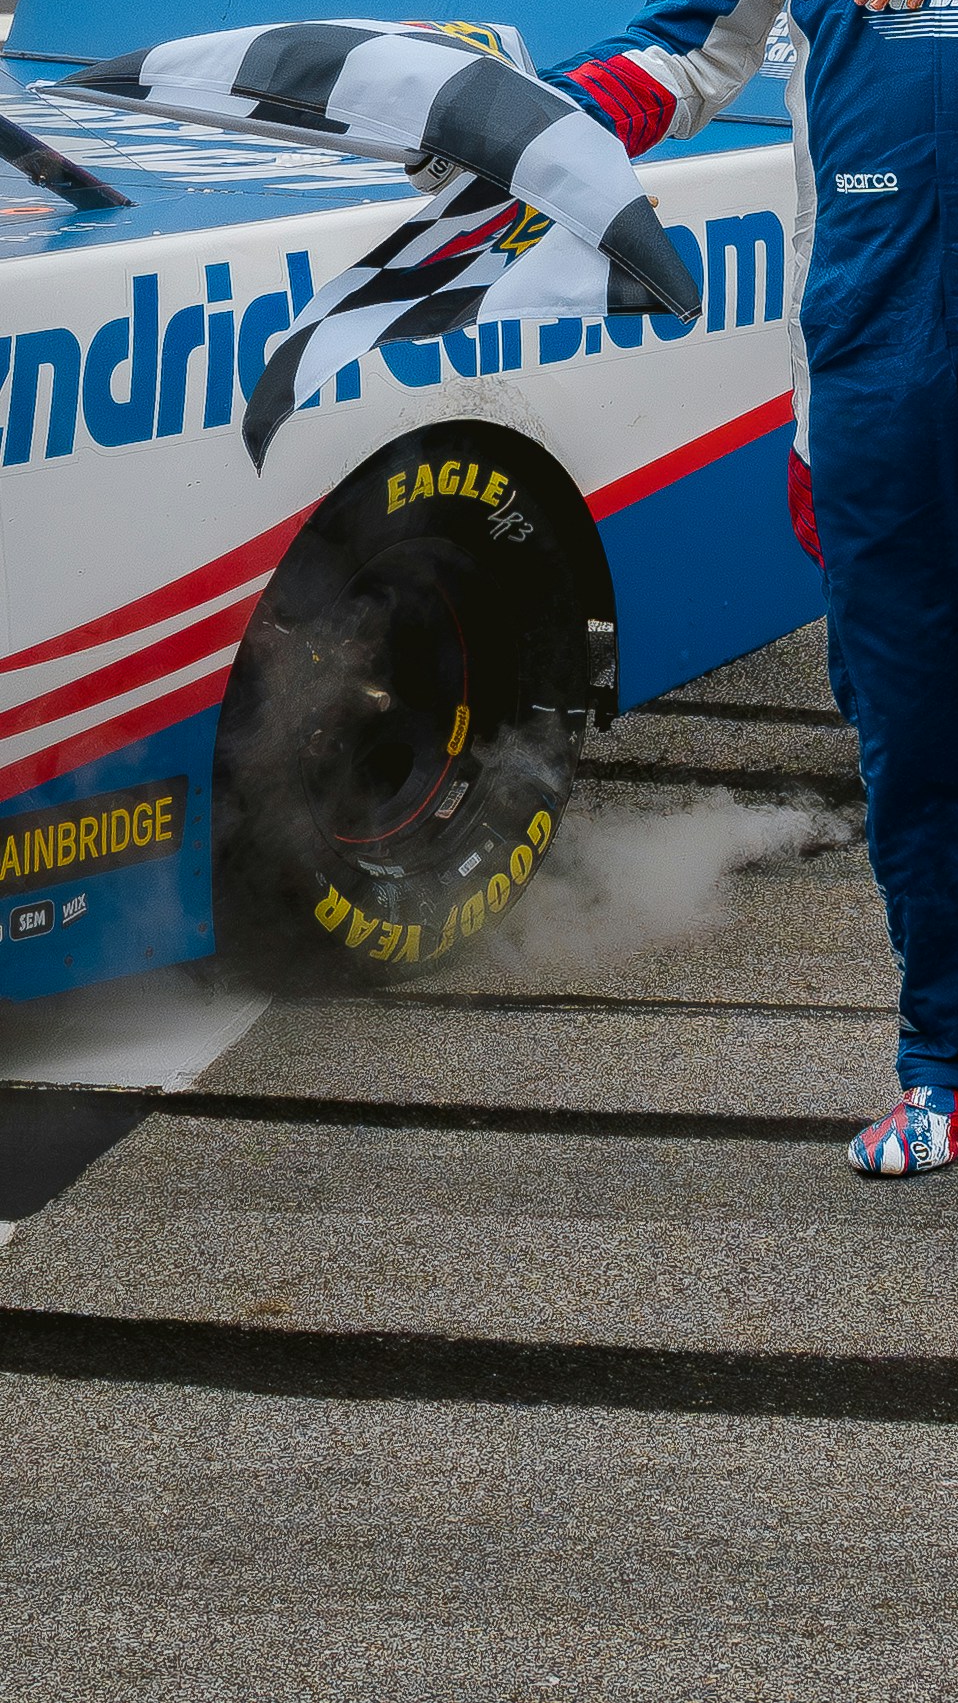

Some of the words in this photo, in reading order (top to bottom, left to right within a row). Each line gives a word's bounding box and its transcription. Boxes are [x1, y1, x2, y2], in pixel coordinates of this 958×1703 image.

[836, 172, 899, 194] sparco
[387, 460, 508, 514] EAGLE
[62, 893, 87, 919] WIX
[19, 909, 46, 932] SEM
